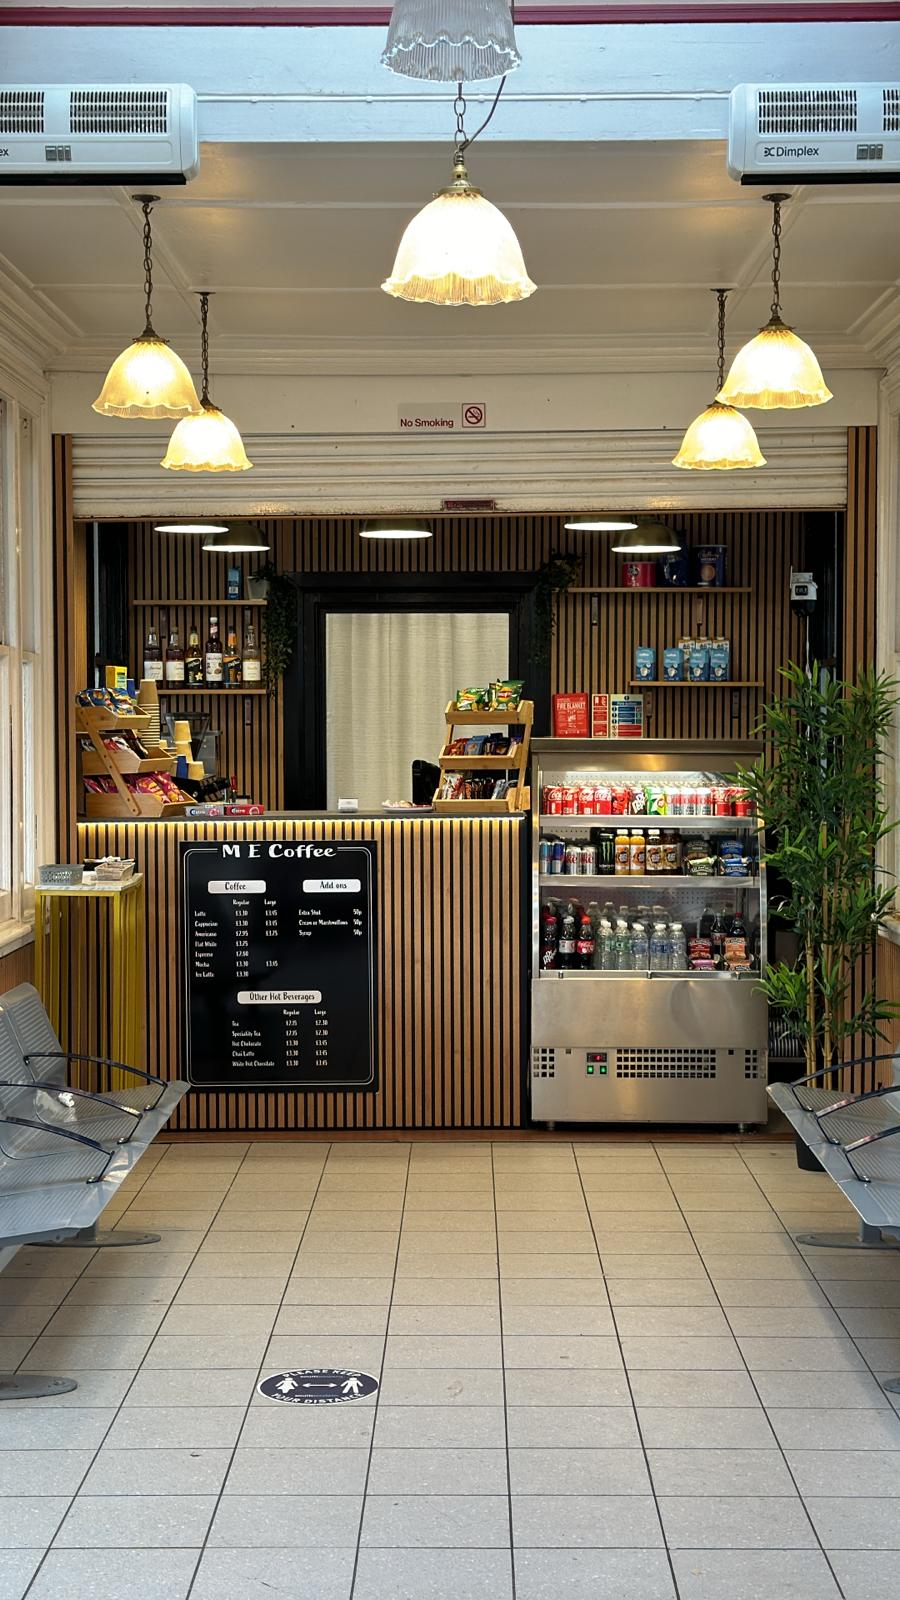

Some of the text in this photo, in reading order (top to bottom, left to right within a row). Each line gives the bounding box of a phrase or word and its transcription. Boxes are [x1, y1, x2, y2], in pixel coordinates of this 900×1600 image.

[776, 146, 819, 157] Dimplex
[400, 418, 454, 429] No Smoking
[222, 843, 336, 859] M E Coffee
[224, 881, 247, 891] Coffee
[319, 880, 348, 890] Add ons
[232, 898, 277, 907] Regular Large
[249, 991, 315, 1003] Other Hot Beverages
[282, 1008, 327, 1017] Regular Large
[282, 1368, 330, 1378] PLEASE
[332, 1368, 363, 1378] KEEP
[270, 1392, 366, 1405] YOUR DISTANCE
